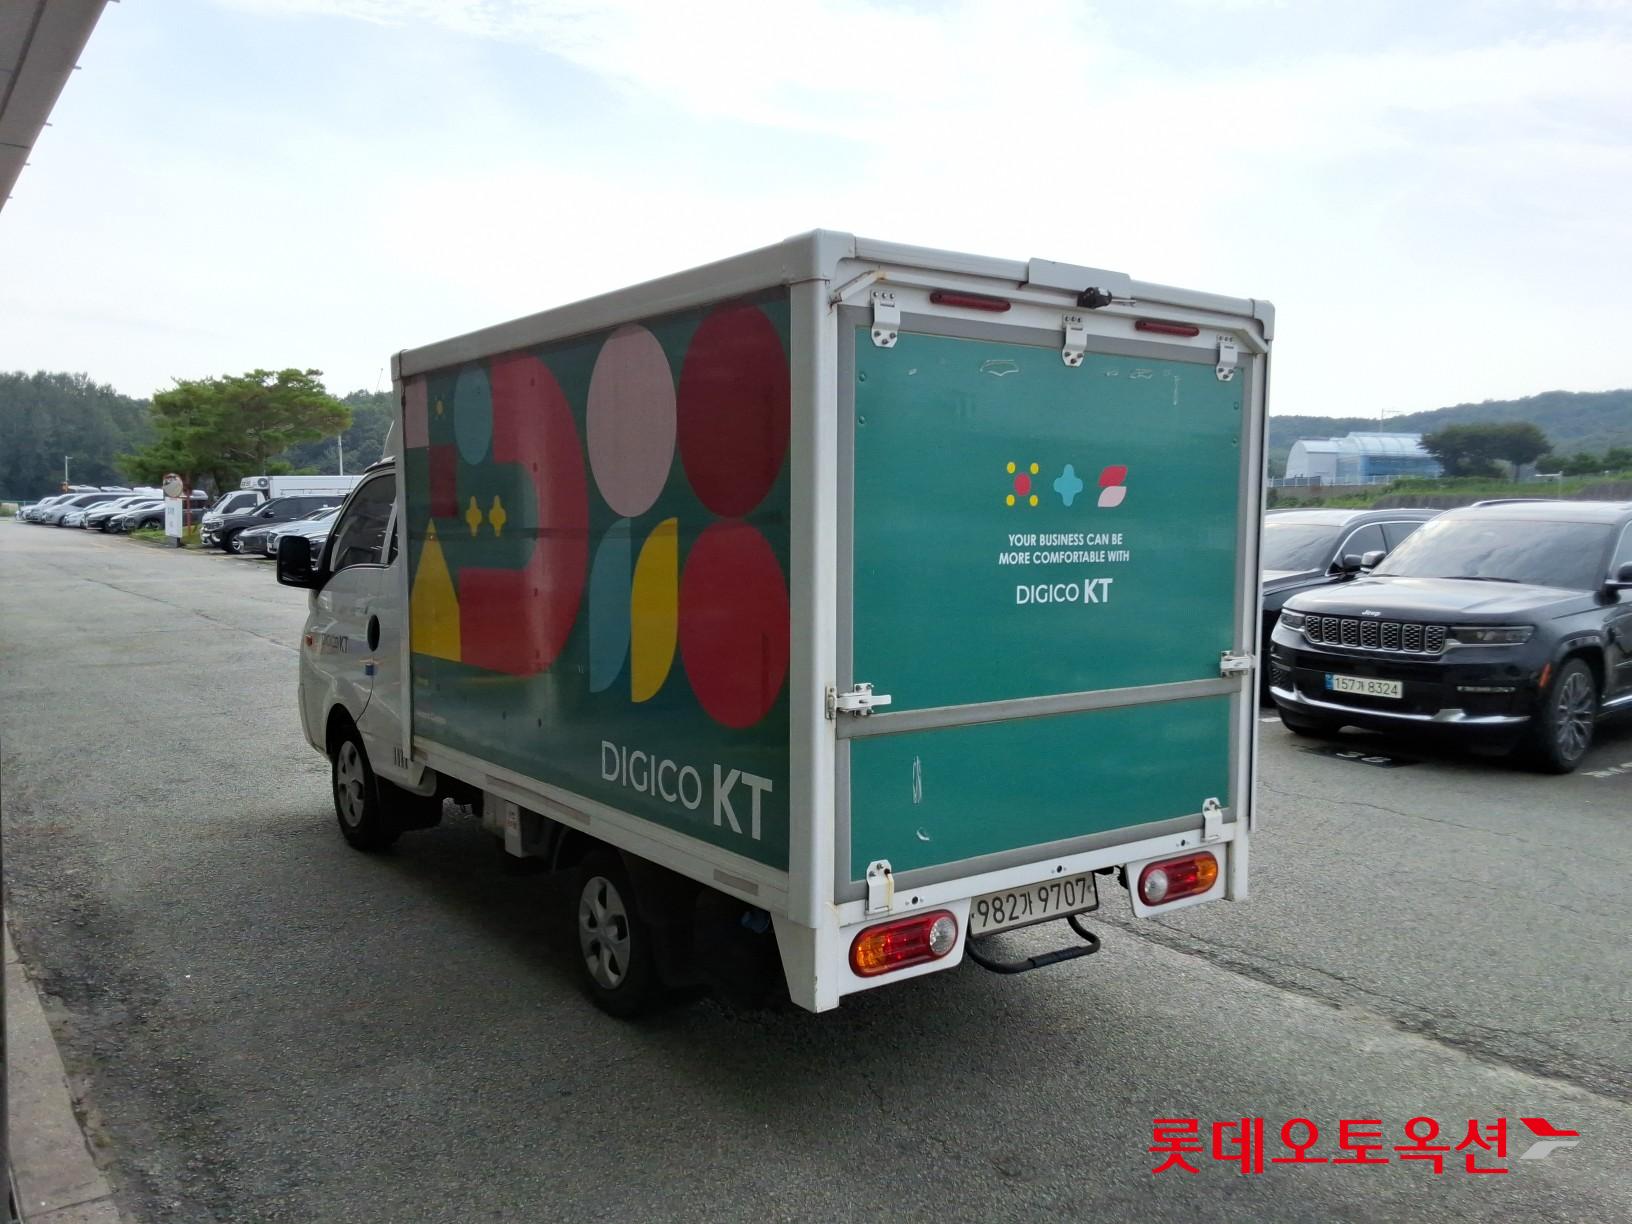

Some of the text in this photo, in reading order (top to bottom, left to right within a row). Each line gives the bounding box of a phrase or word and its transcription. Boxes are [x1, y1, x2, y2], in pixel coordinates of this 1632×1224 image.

[1008, 533, 1123, 547] YOUR BUSINESS CAN BE
[999, 550, 1130, 565] MORE COMFORTABLE WITH
[1016, 578, 1113, 605] DIGICO KT
[1367, 681, 1398, 696] 8324
[601, 740, 773, 841] DIGICO KT
[977, 877, 1087, 928] 982가 9707
